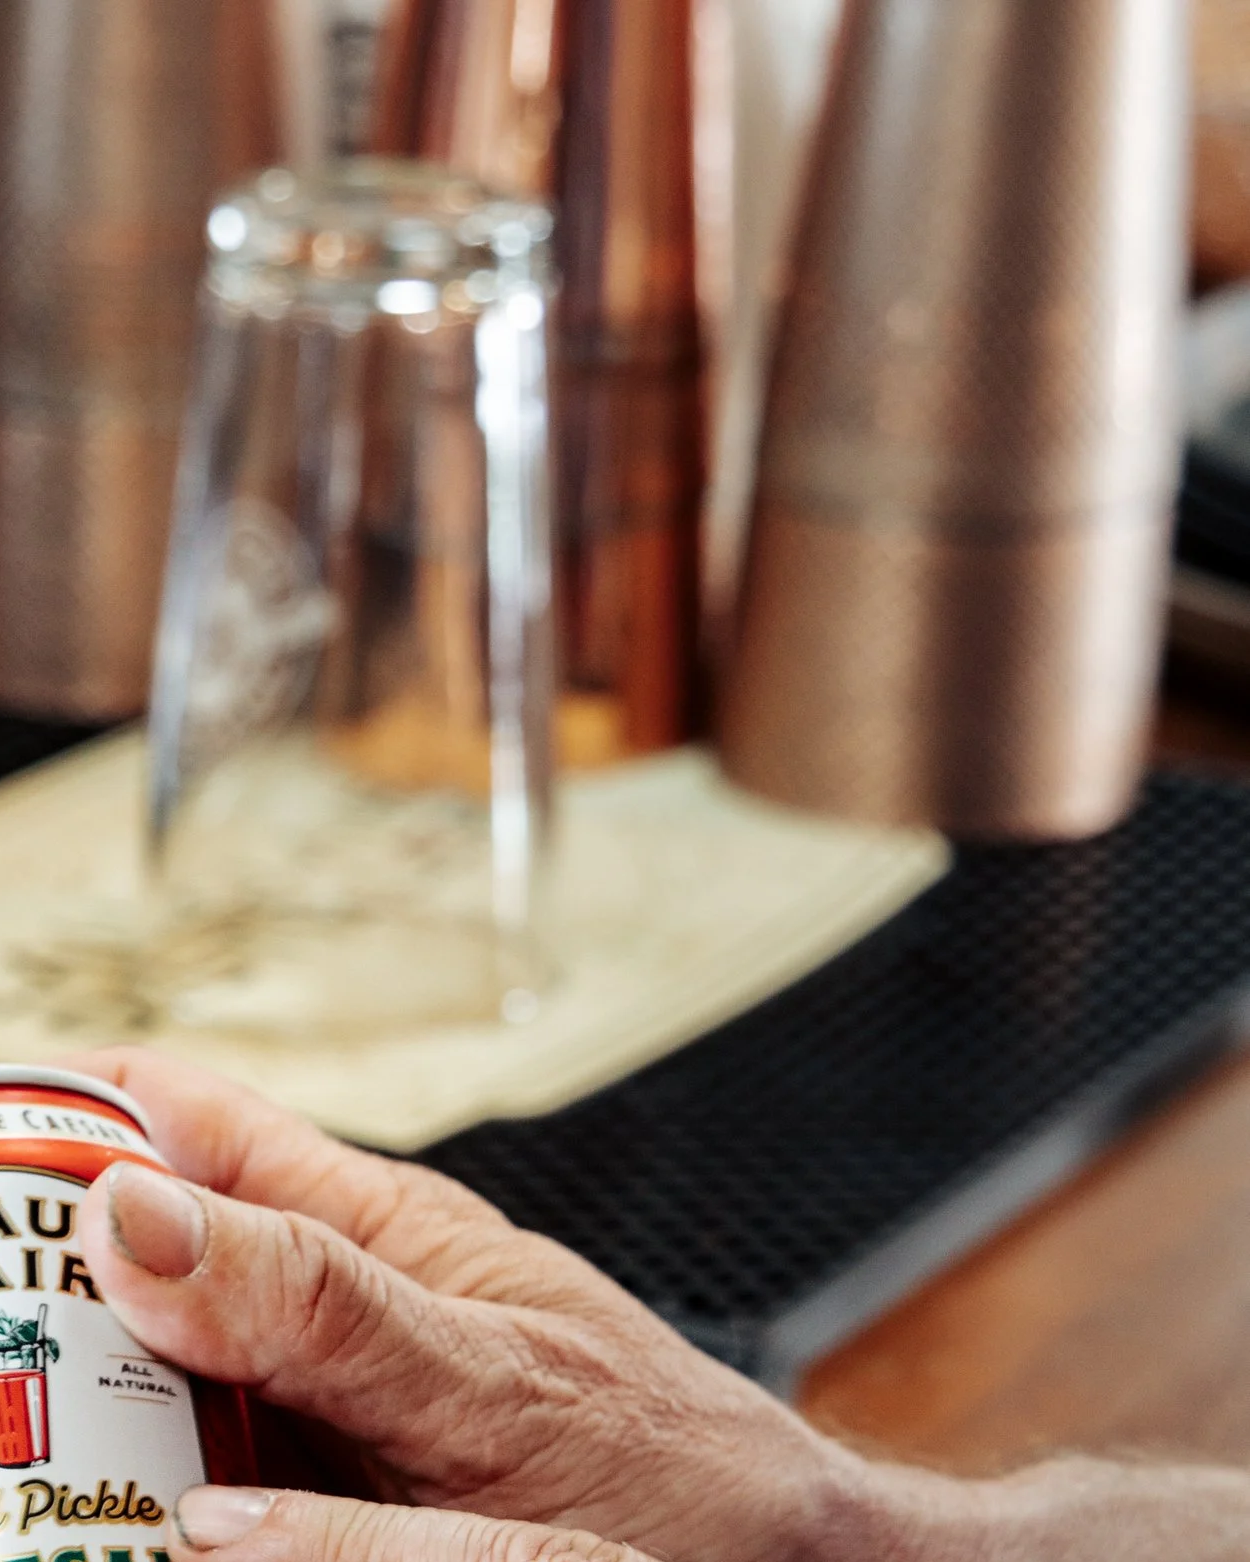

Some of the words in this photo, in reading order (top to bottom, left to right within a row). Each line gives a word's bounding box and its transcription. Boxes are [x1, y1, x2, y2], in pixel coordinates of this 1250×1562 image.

[121, 1362, 154, 1377] ALL
[97, 1376, 178, 1397] NATURAL
[17, 1477, 167, 1536] Pickle
